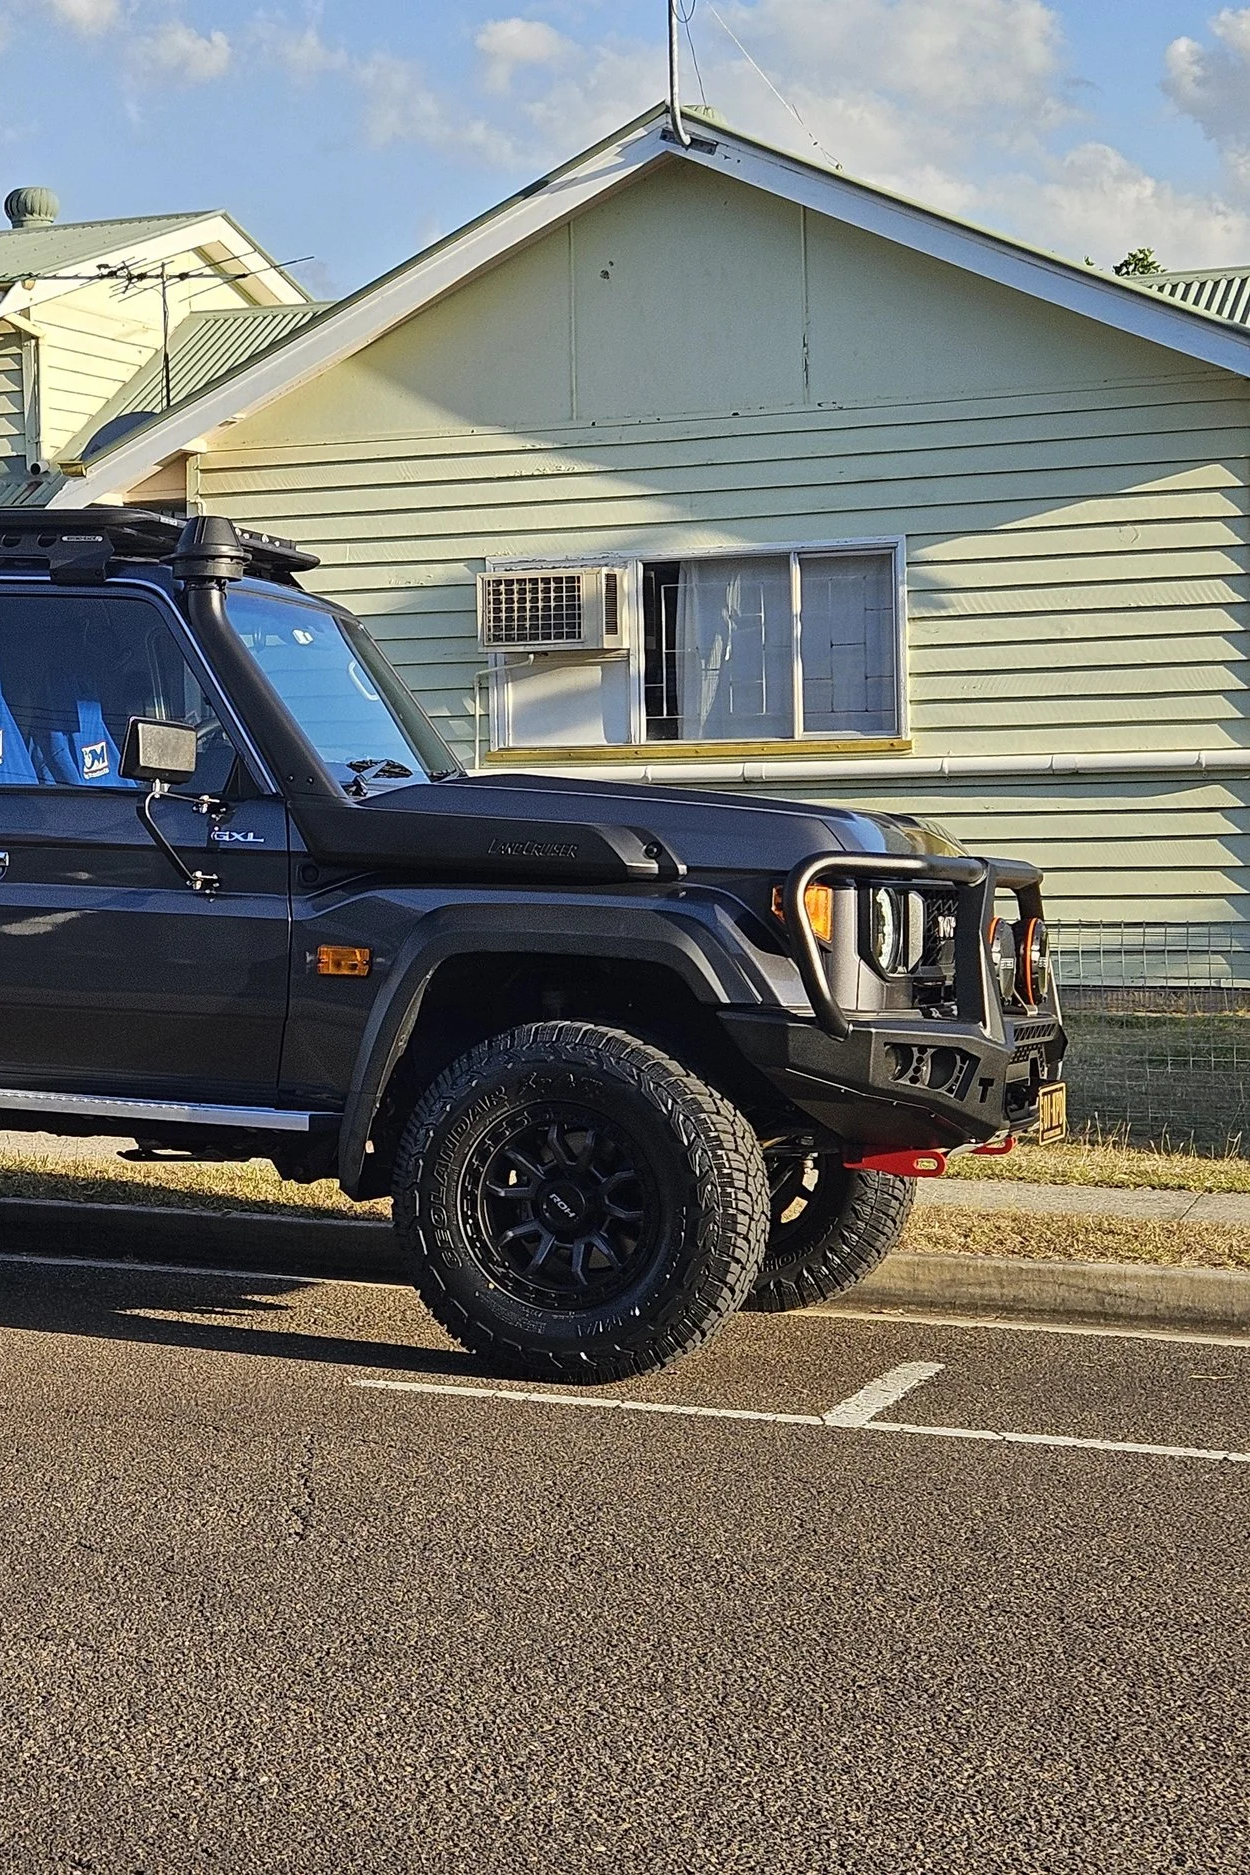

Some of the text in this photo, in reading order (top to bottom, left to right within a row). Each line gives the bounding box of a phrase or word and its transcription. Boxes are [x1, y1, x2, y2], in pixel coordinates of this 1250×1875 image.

[211, 831, 265, 843] GXL
[430, 1085, 508, 1269] GEOLANDAR
[549, 1193, 578, 1219] ROH
